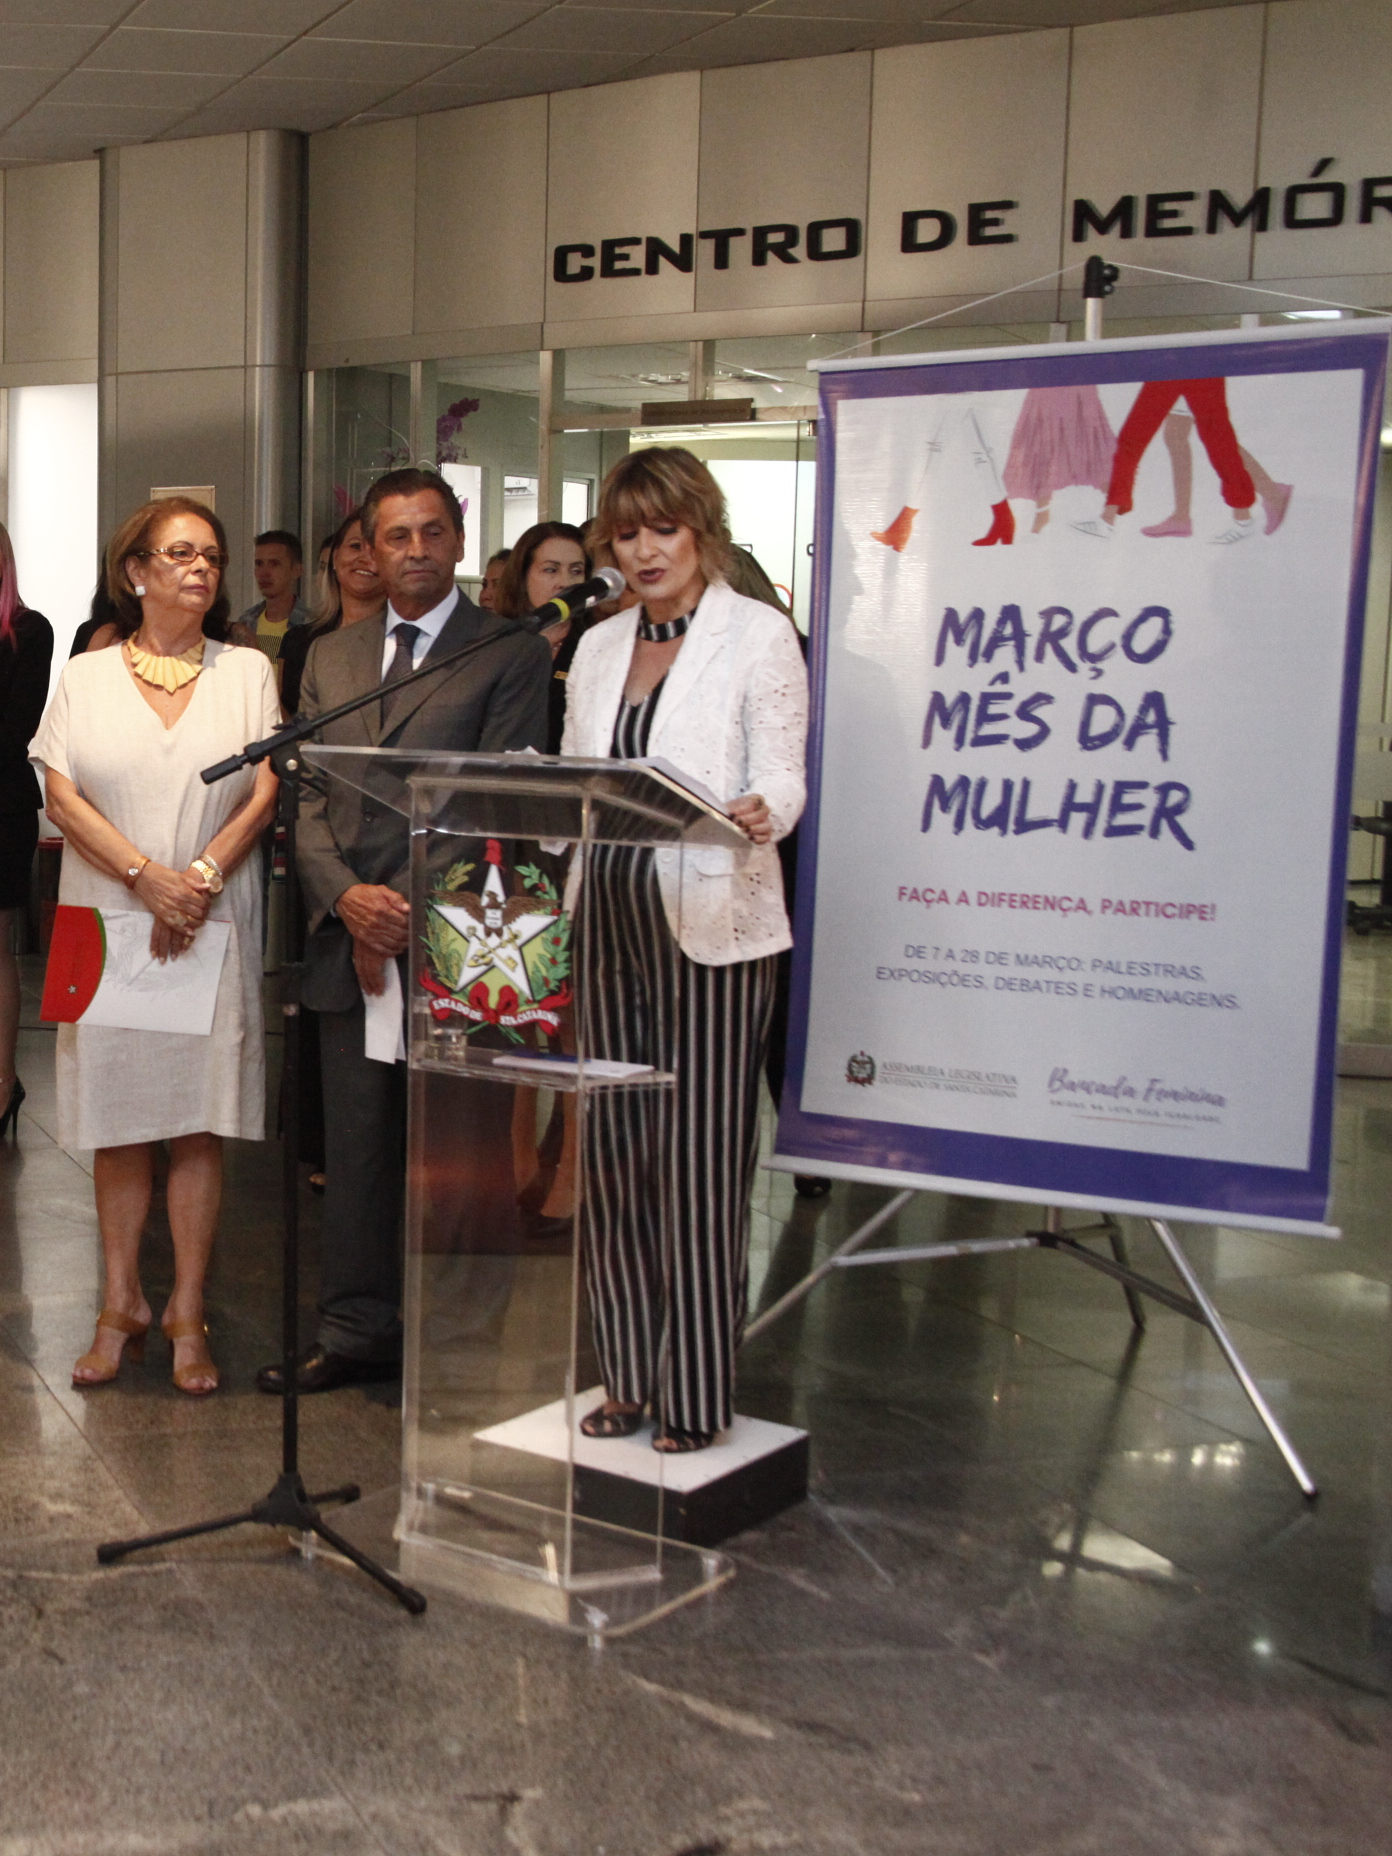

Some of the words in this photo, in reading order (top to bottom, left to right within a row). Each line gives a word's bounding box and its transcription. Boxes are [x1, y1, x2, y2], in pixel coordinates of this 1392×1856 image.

[553, 217, 862, 284] CENTRO
[901, 200, 1018, 254] DE
[934, 603, 1175, 680] MARÇO
[921, 672, 1056, 751] MÊS
[1078, 690, 1175, 762] DA
[920, 774, 1196, 851] MULHER
[897, 886, 950, 909] FAÇA
[955, 889, 970, 907] A
[977, 891, 1094, 918] DIFERENÇA,
[1100, 898, 1217, 922] PARTICIPE!
[904, 944, 927, 960] DE
[931, 947, 941, 961] 7
[943, 948, 956, 962] A
[960, 949, 980, 965] 28
[984, 951, 1009, 967] DE
[994, 975, 1078, 998] DEBATES
[1082, 983, 1094, 998] E
